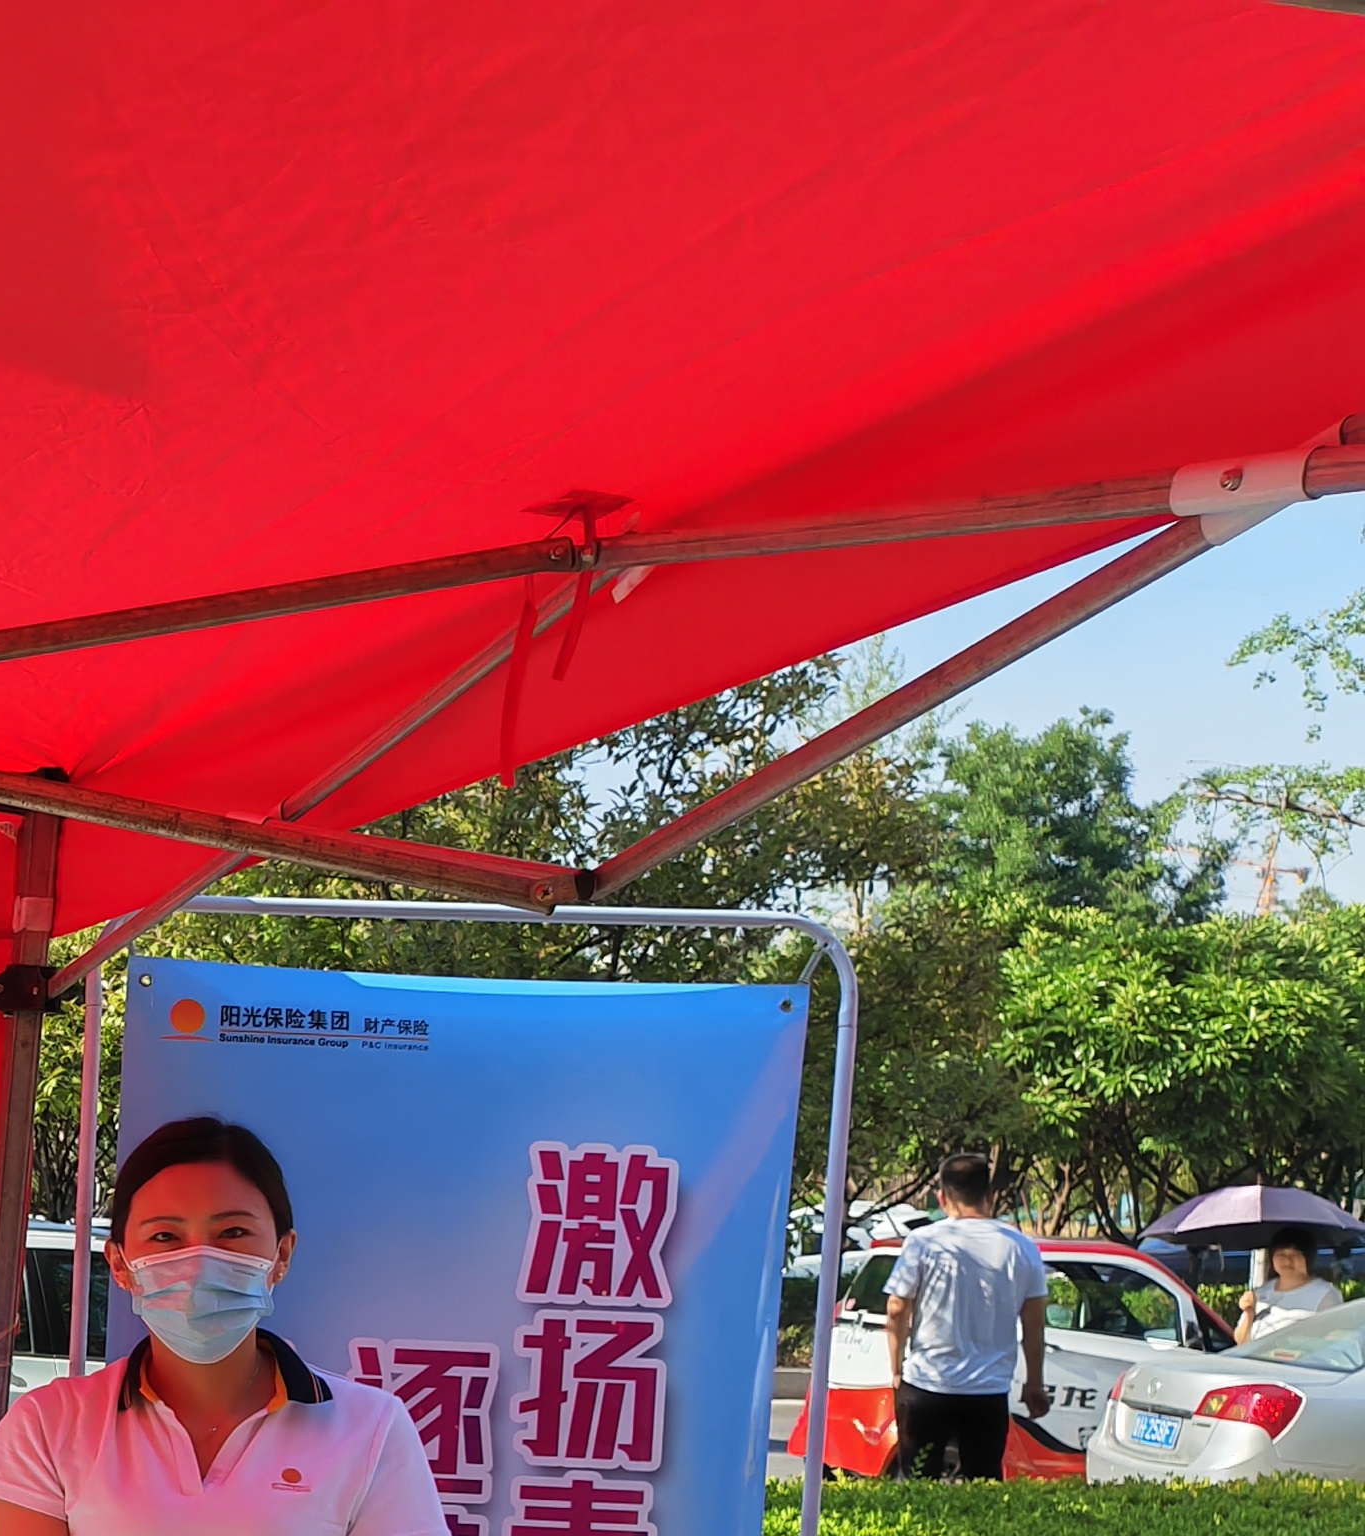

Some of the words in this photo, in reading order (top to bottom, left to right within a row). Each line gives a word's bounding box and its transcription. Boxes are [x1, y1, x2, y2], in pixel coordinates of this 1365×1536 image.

[220, 1005, 350, 1031] 阳光保险集团
[363, 1017, 430, 1036] 财产保险
[219, 1032, 265, 1044] Sunshine
[267, 1035, 315, 1046] Insurance
[317, 1037, 349, 1049] Group
